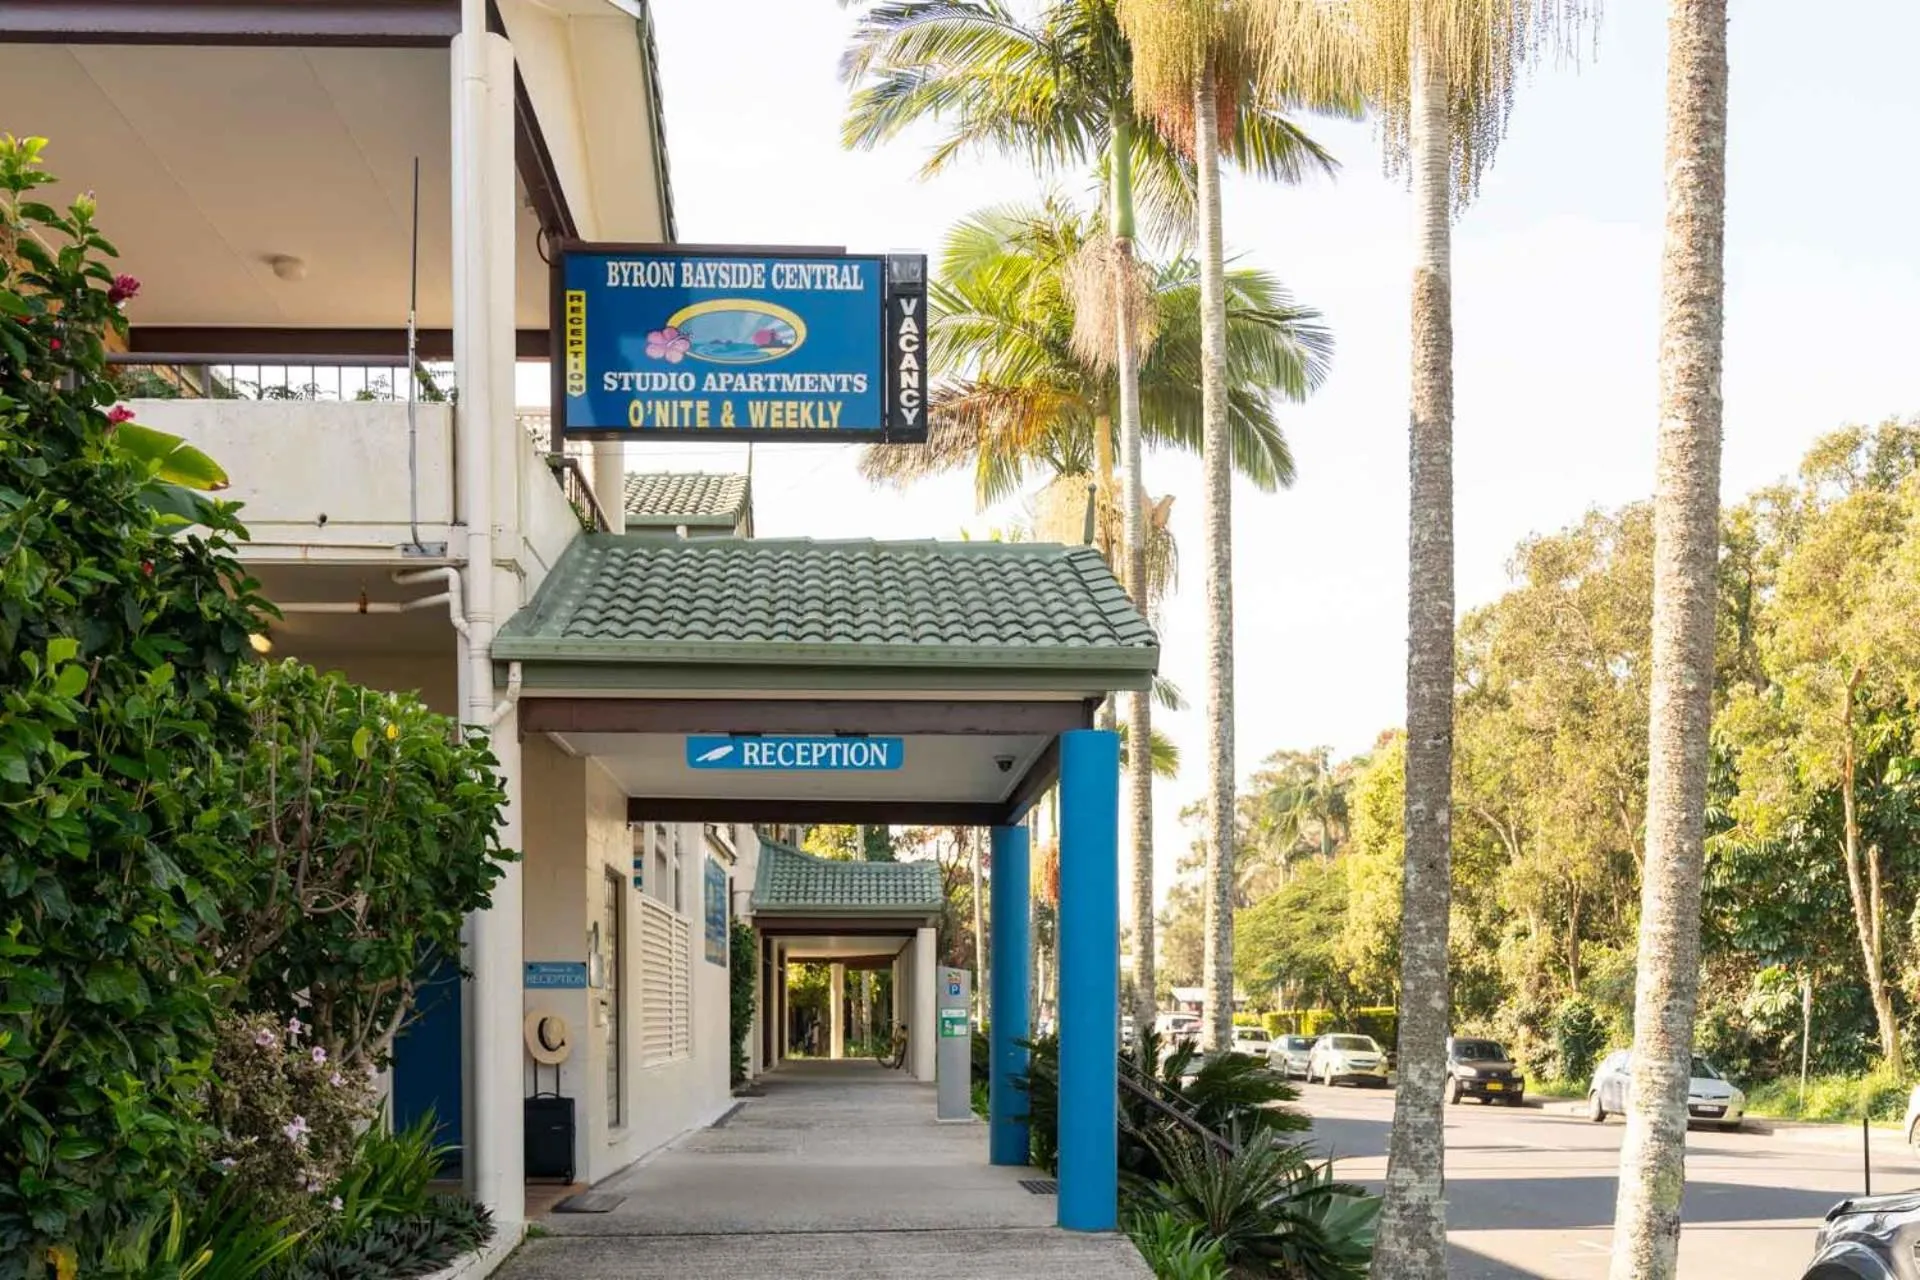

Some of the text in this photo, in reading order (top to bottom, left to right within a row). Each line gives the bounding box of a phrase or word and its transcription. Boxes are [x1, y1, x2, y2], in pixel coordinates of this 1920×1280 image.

[606, 261, 675, 288] BYRON
[680, 262, 766, 289] BAYSIDE
[771, 264, 864, 290] CENTRAL
[568, 294, 584, 392] RECEPTION
[899, 298, 920, 425] VACANCY
[603, 371, 868, 393] STUDIO APARTMENTS
[628, 400, 843, 428] O'NITE & WEEKLY
[742, 742, 888, 766] RECEPTION
